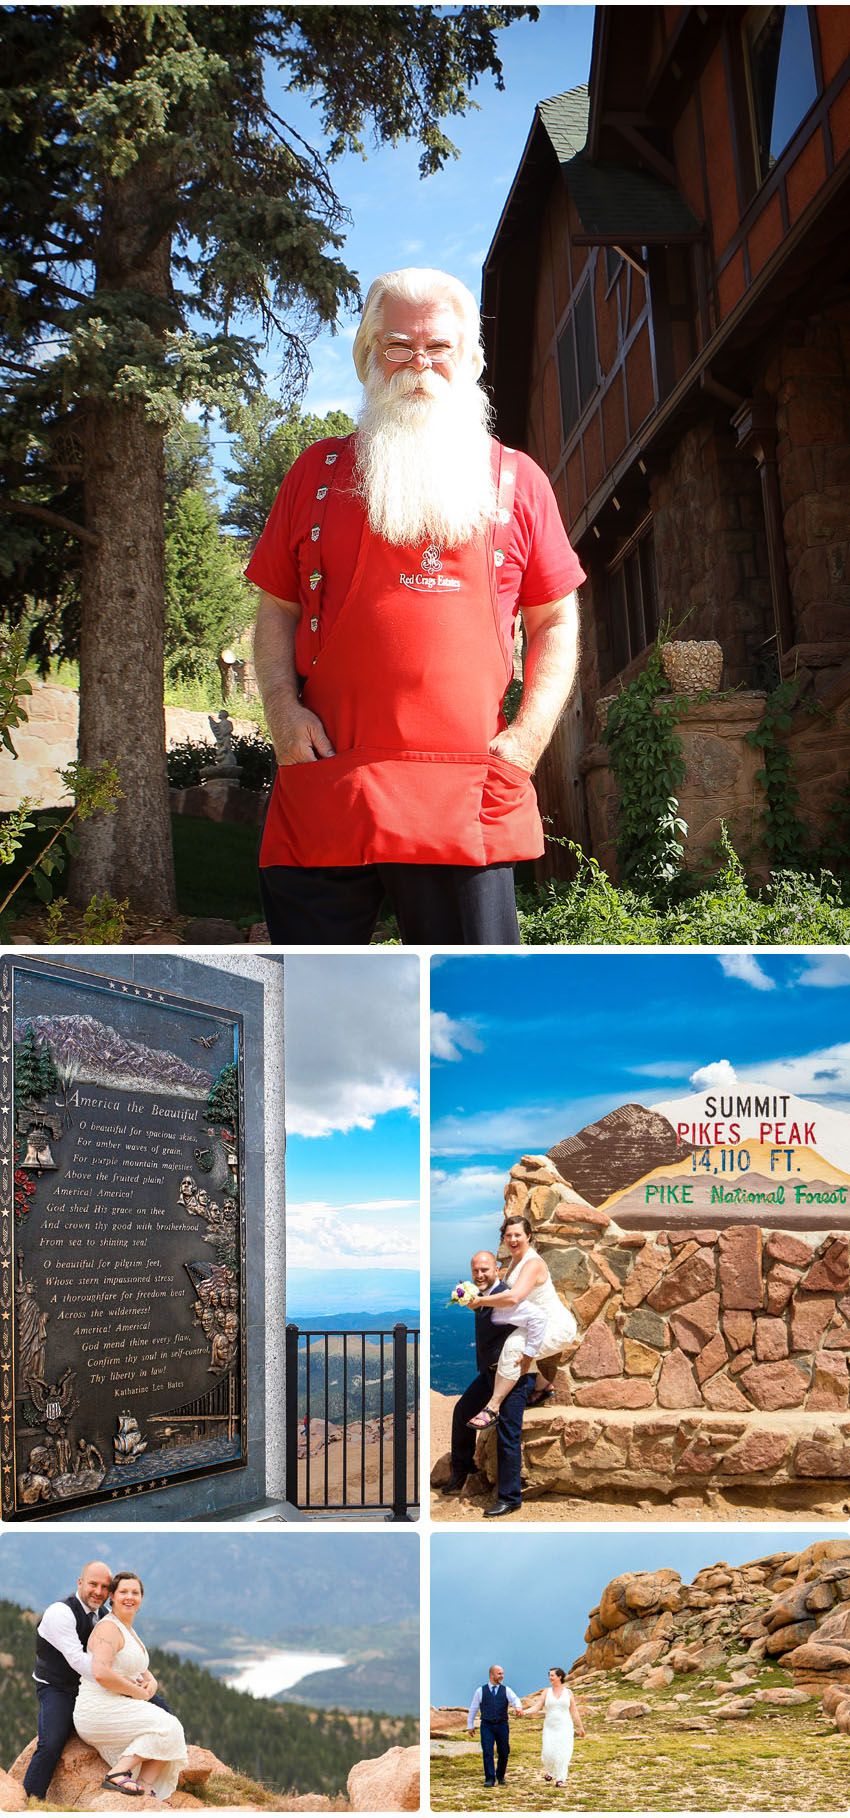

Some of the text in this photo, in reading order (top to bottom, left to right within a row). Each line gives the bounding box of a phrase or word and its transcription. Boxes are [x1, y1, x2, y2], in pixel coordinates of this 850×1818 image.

[400, 573, 414, 584] Red
[416, 574, 436, 588] Crags
[69, 1090, 198, 1122] America the Beautiful
[704, 1096, 790, 1118] SUMMIT
[80, 1121, 86, 1129] O
[91, 1122, 126, 1135] beautiful
[129, 1126, 141, 1136] for
[146, 1130, 176, 1140] spacious
[676, 1122, 817, 1145] PIKES PEAK
[77, 1137, 92, 1146] For
[96, 1140, 121, 1149] amber
[125, 1143, 147, 1152] waves
[151, 1145, 160, 1154] of
[72, 1154, 193, 1171] For purple mountain majesties
[691, 1149, 800, 1174] 14,110 FT.
[64, 1170, 164, 1185] Above the fruited plain!
[53, 1187, 133, 1198] America! America!
[645, 1185, 848, 1205] PIKE National Forest
[46, 1203, 65, 1212] God
[69, 1204, 89, 1213] shed
[94, 1205, 107, 1213] His
[111, 1207, 132, 1215] grace
[150, 1207, 165, 1215] thee
[40, 1220, 199, 1231] And crown thy good with brotherhood
[39, 1238, 64, 1246] From
[86, 1238, 95, 1246] to
[100, 1238, 128, 1248] shining
[43, 1260, 52, 1269] O
[55, 1259, 94, 1270] beautiful
[98, 1259, 110, 1270] for
[114, 1259, 142, 1270] pilgrim
[45, 1274, 174, 1286] Whose stern impassioned stress
[50, 1289, 185, 1303] A thoroughfare for freedom beat
[57, 1306, 150, 1320] Across the wilderness!
[73, 1322, 150, 1335] America! America!
[81, 1342, 99, 1352] God
[103, 1340, 125, 1350] mend
[130, 1338, 149, 1346] thine
[152, 1337, 170, 1345] every
[87, 1357, 120, 1368] Confirm
[125, 1354, 138, 1363] thy
[142, 1352, 156, 1361] soul
[90, 1366, 166, 1384] Thy liberty in law!
[115, 1387, 148, 1397] Katharine
[168, 1381, 184, 1389] Bates
